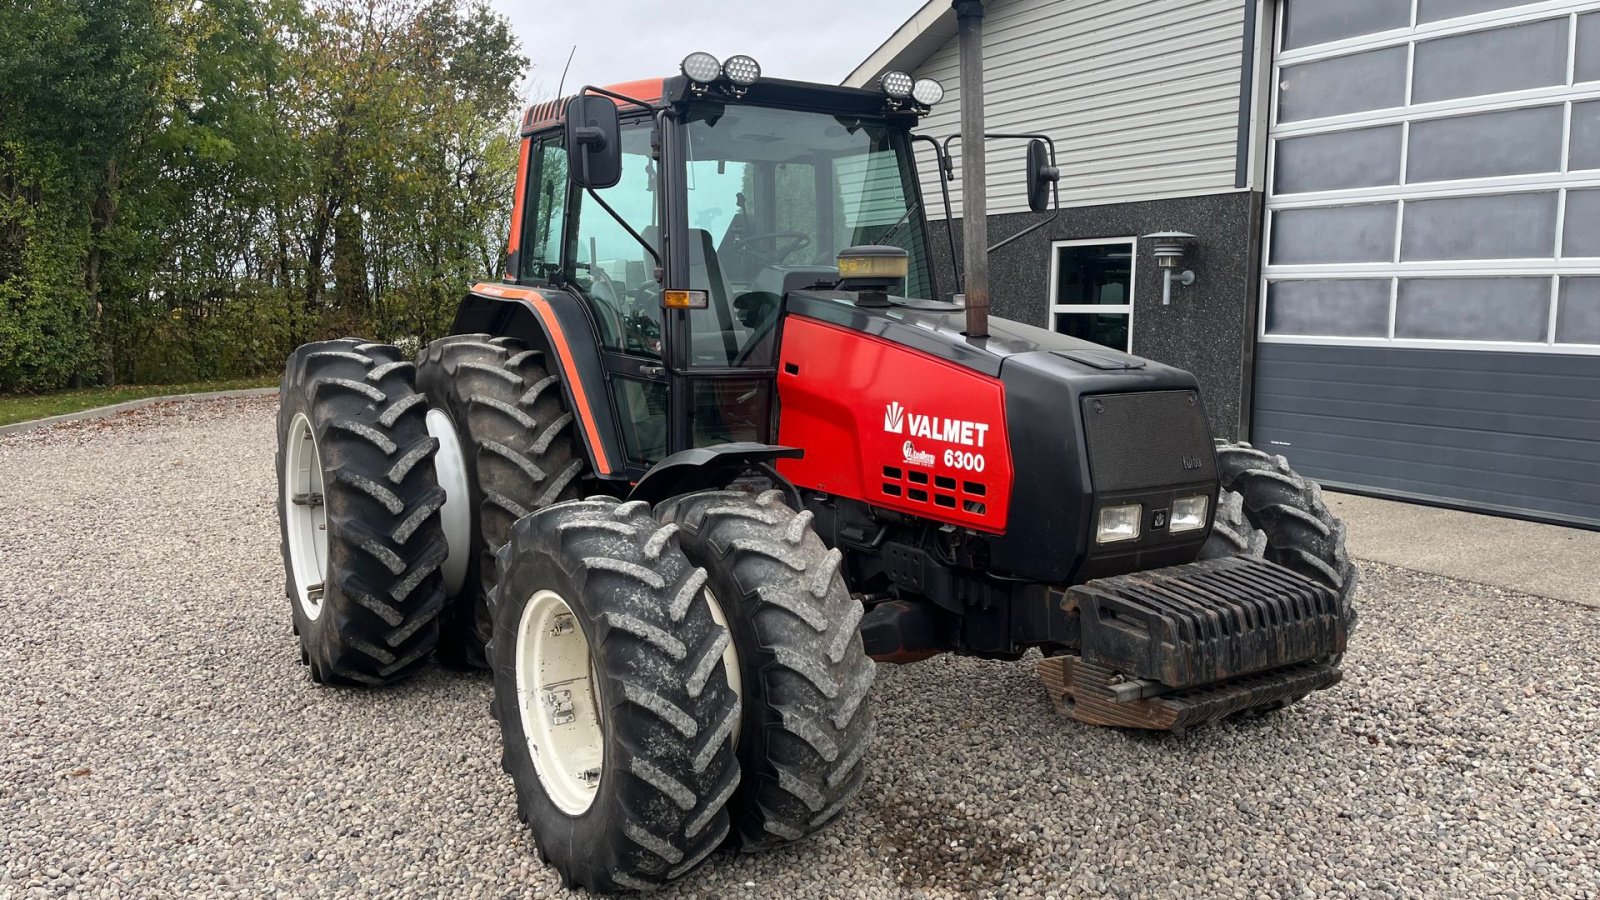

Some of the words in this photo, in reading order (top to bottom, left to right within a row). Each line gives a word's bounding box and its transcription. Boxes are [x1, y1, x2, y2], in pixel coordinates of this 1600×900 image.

[907, 413, 989, 447] VALMET
[943, 449, 985, 472] 6300
[1181, 455, 1202, 470] turbo
